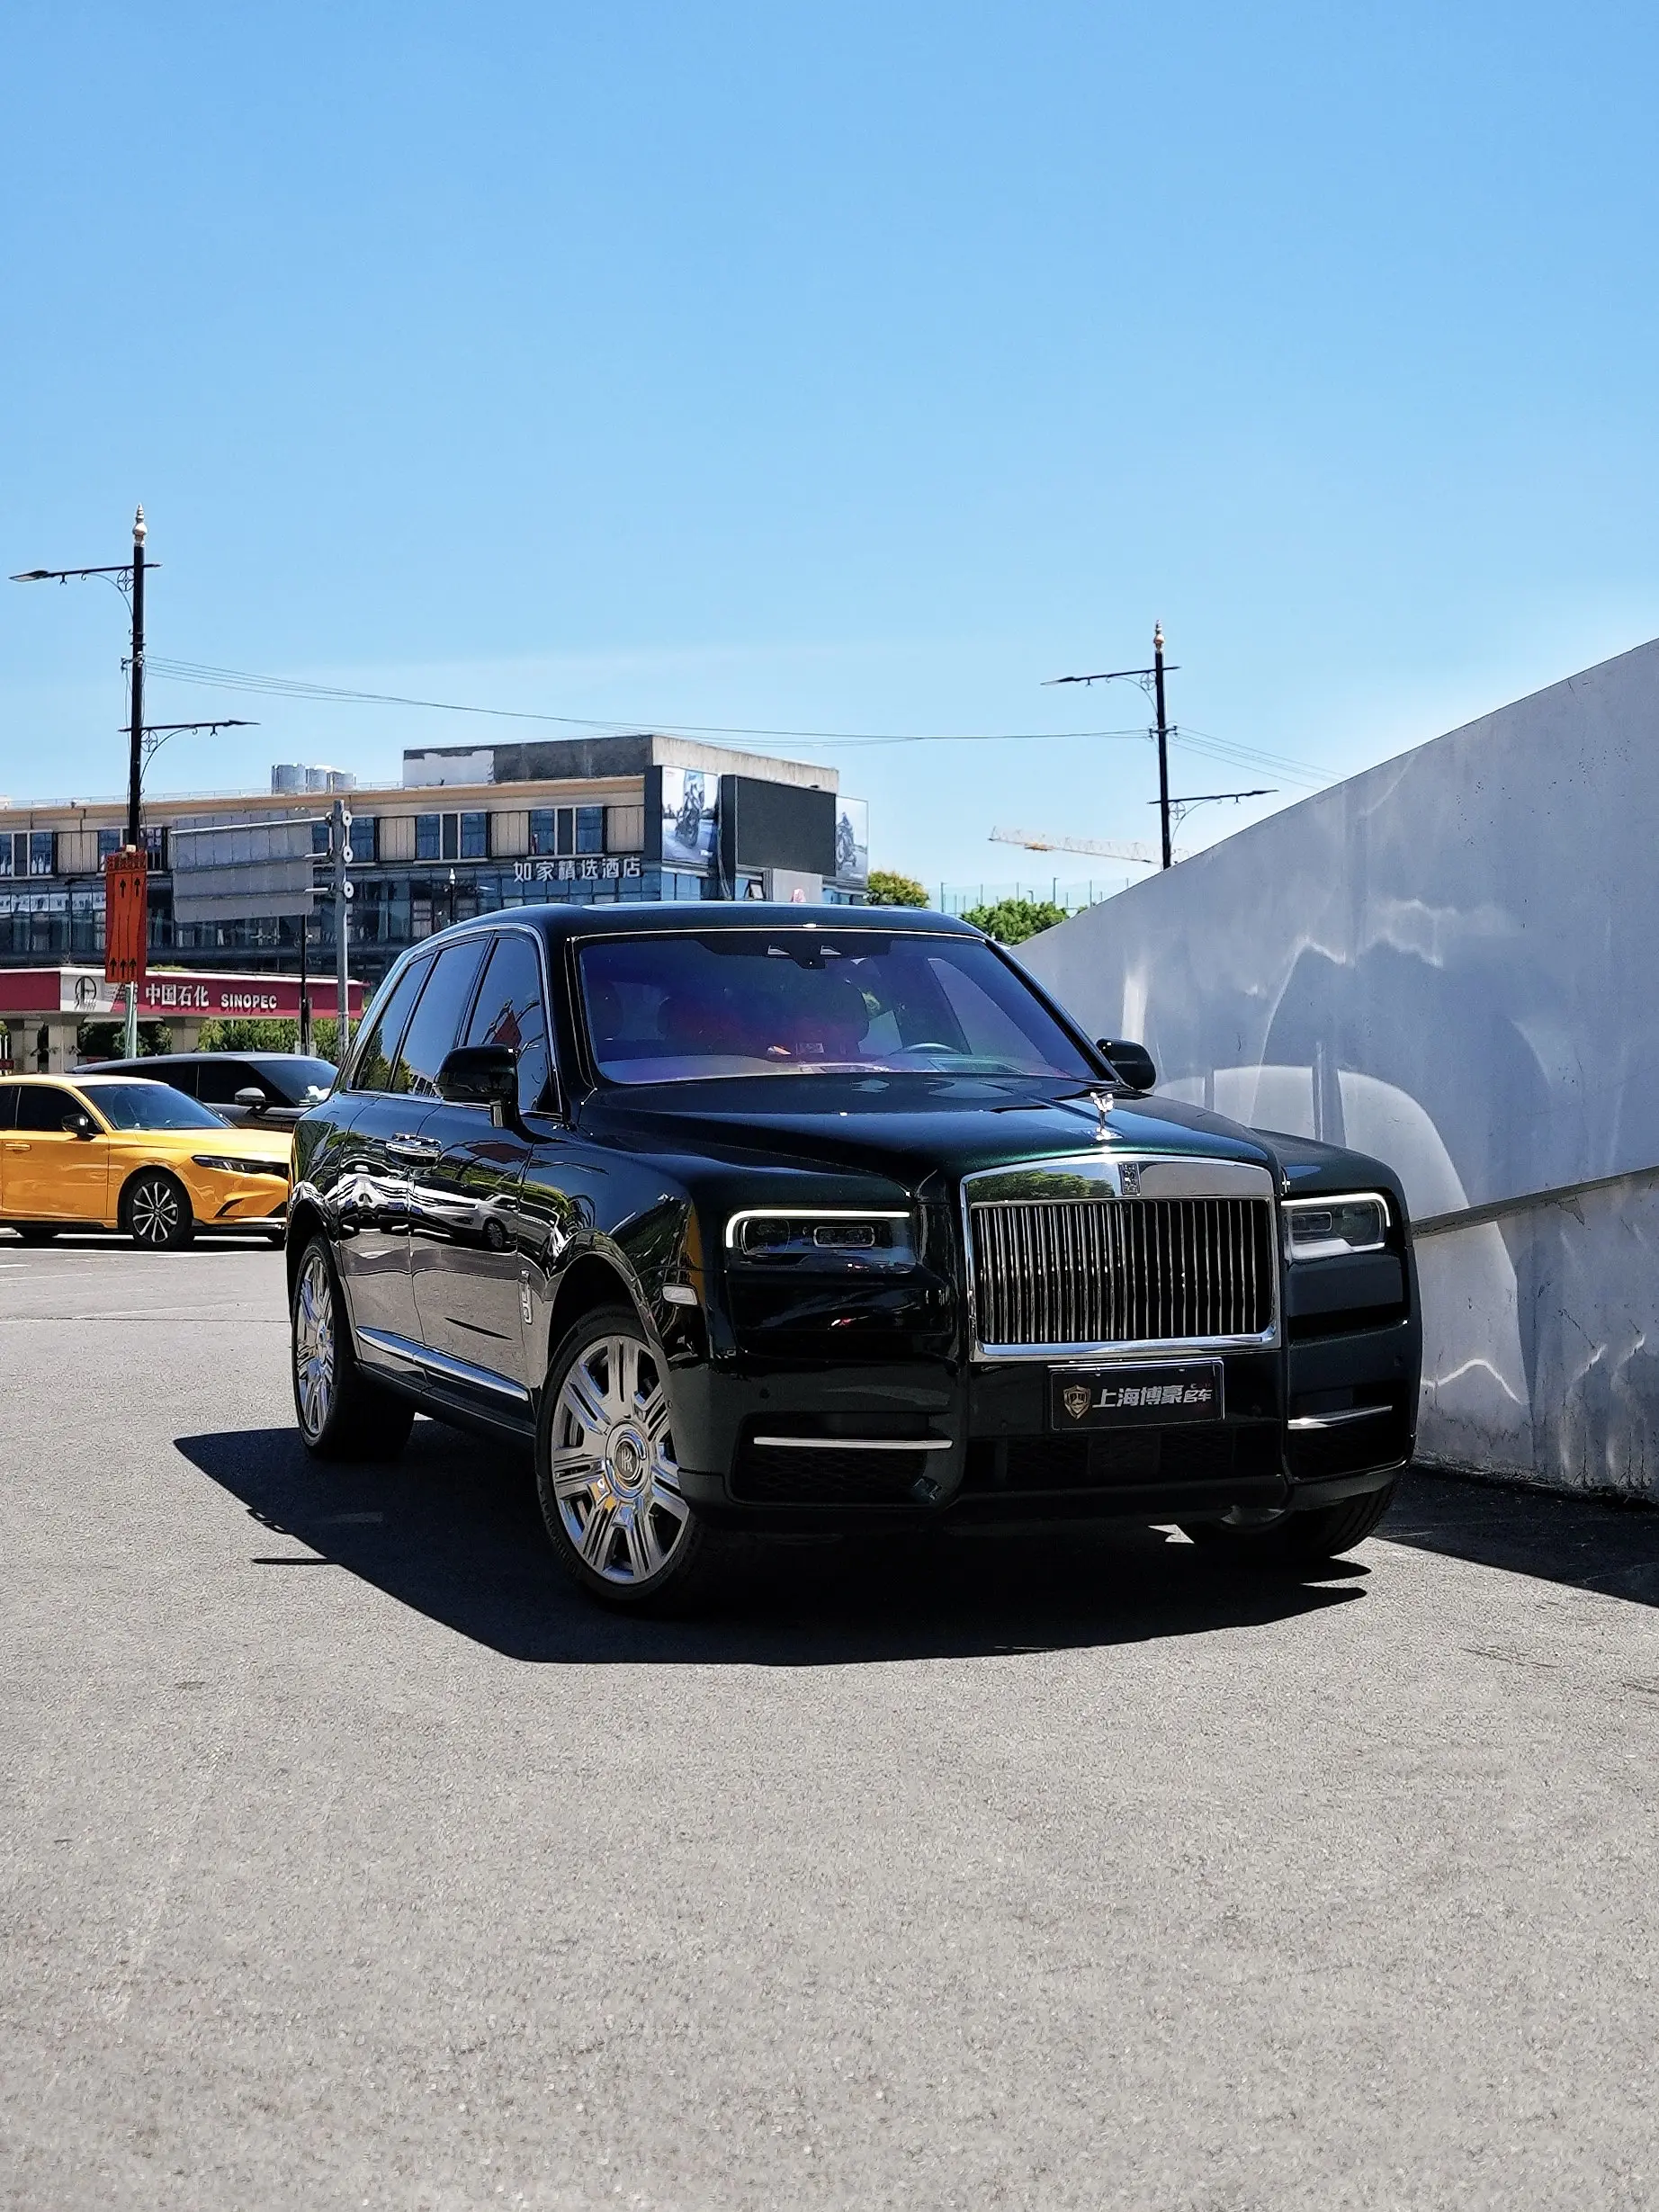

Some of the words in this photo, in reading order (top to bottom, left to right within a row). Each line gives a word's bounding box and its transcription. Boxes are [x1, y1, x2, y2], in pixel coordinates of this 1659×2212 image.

[513, 856, 641, 882] 如家精选酒店
[145, 982, 211, 1007] 中国石化
[220, 993, 278, 1009] SINOPEC
